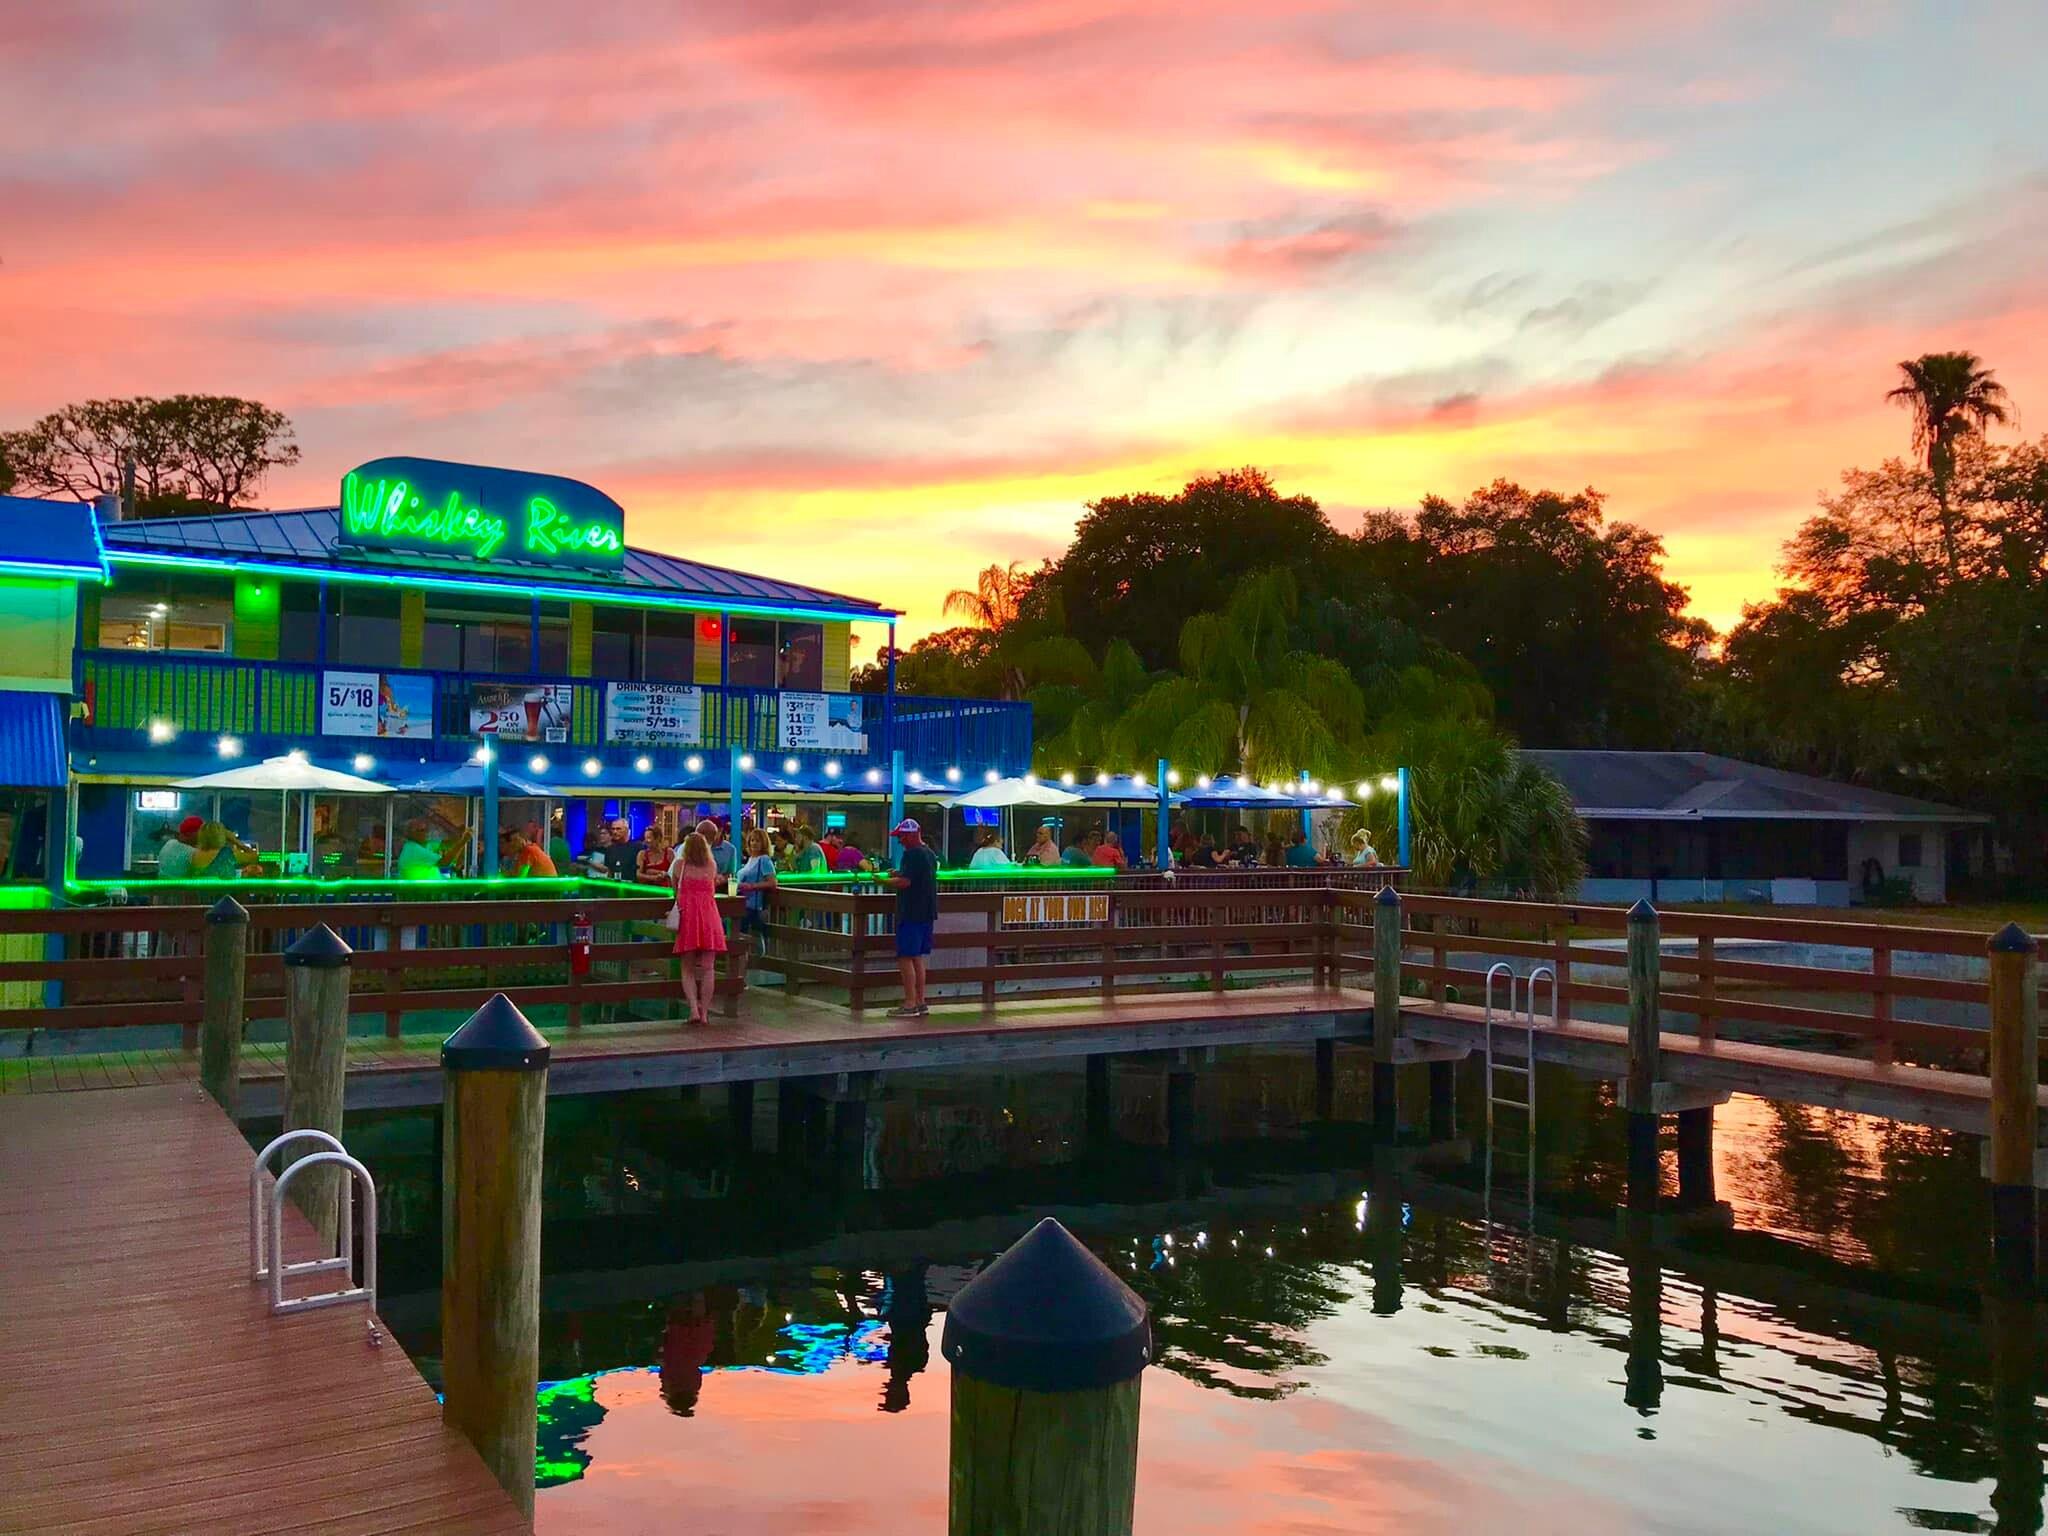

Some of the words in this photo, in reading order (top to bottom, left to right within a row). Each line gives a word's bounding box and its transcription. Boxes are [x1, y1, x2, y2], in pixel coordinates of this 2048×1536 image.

[346, 472, 504, 557] Whiskey
[528, 497, 621, 554] River
[329, 687, 373, 708] 5/$18
[616, 683, 647, 692] DRINK
[649, 685, 693, 695] SPECIALS
[1004, 896, 1027, 923] DOCK
[1030, 896, 1041, 922] AT
[1043, 896, 1065, 921] YOUR
[1067, 896, 1086, 921] OWN
[1089, 896, 1107, 921] RISK
